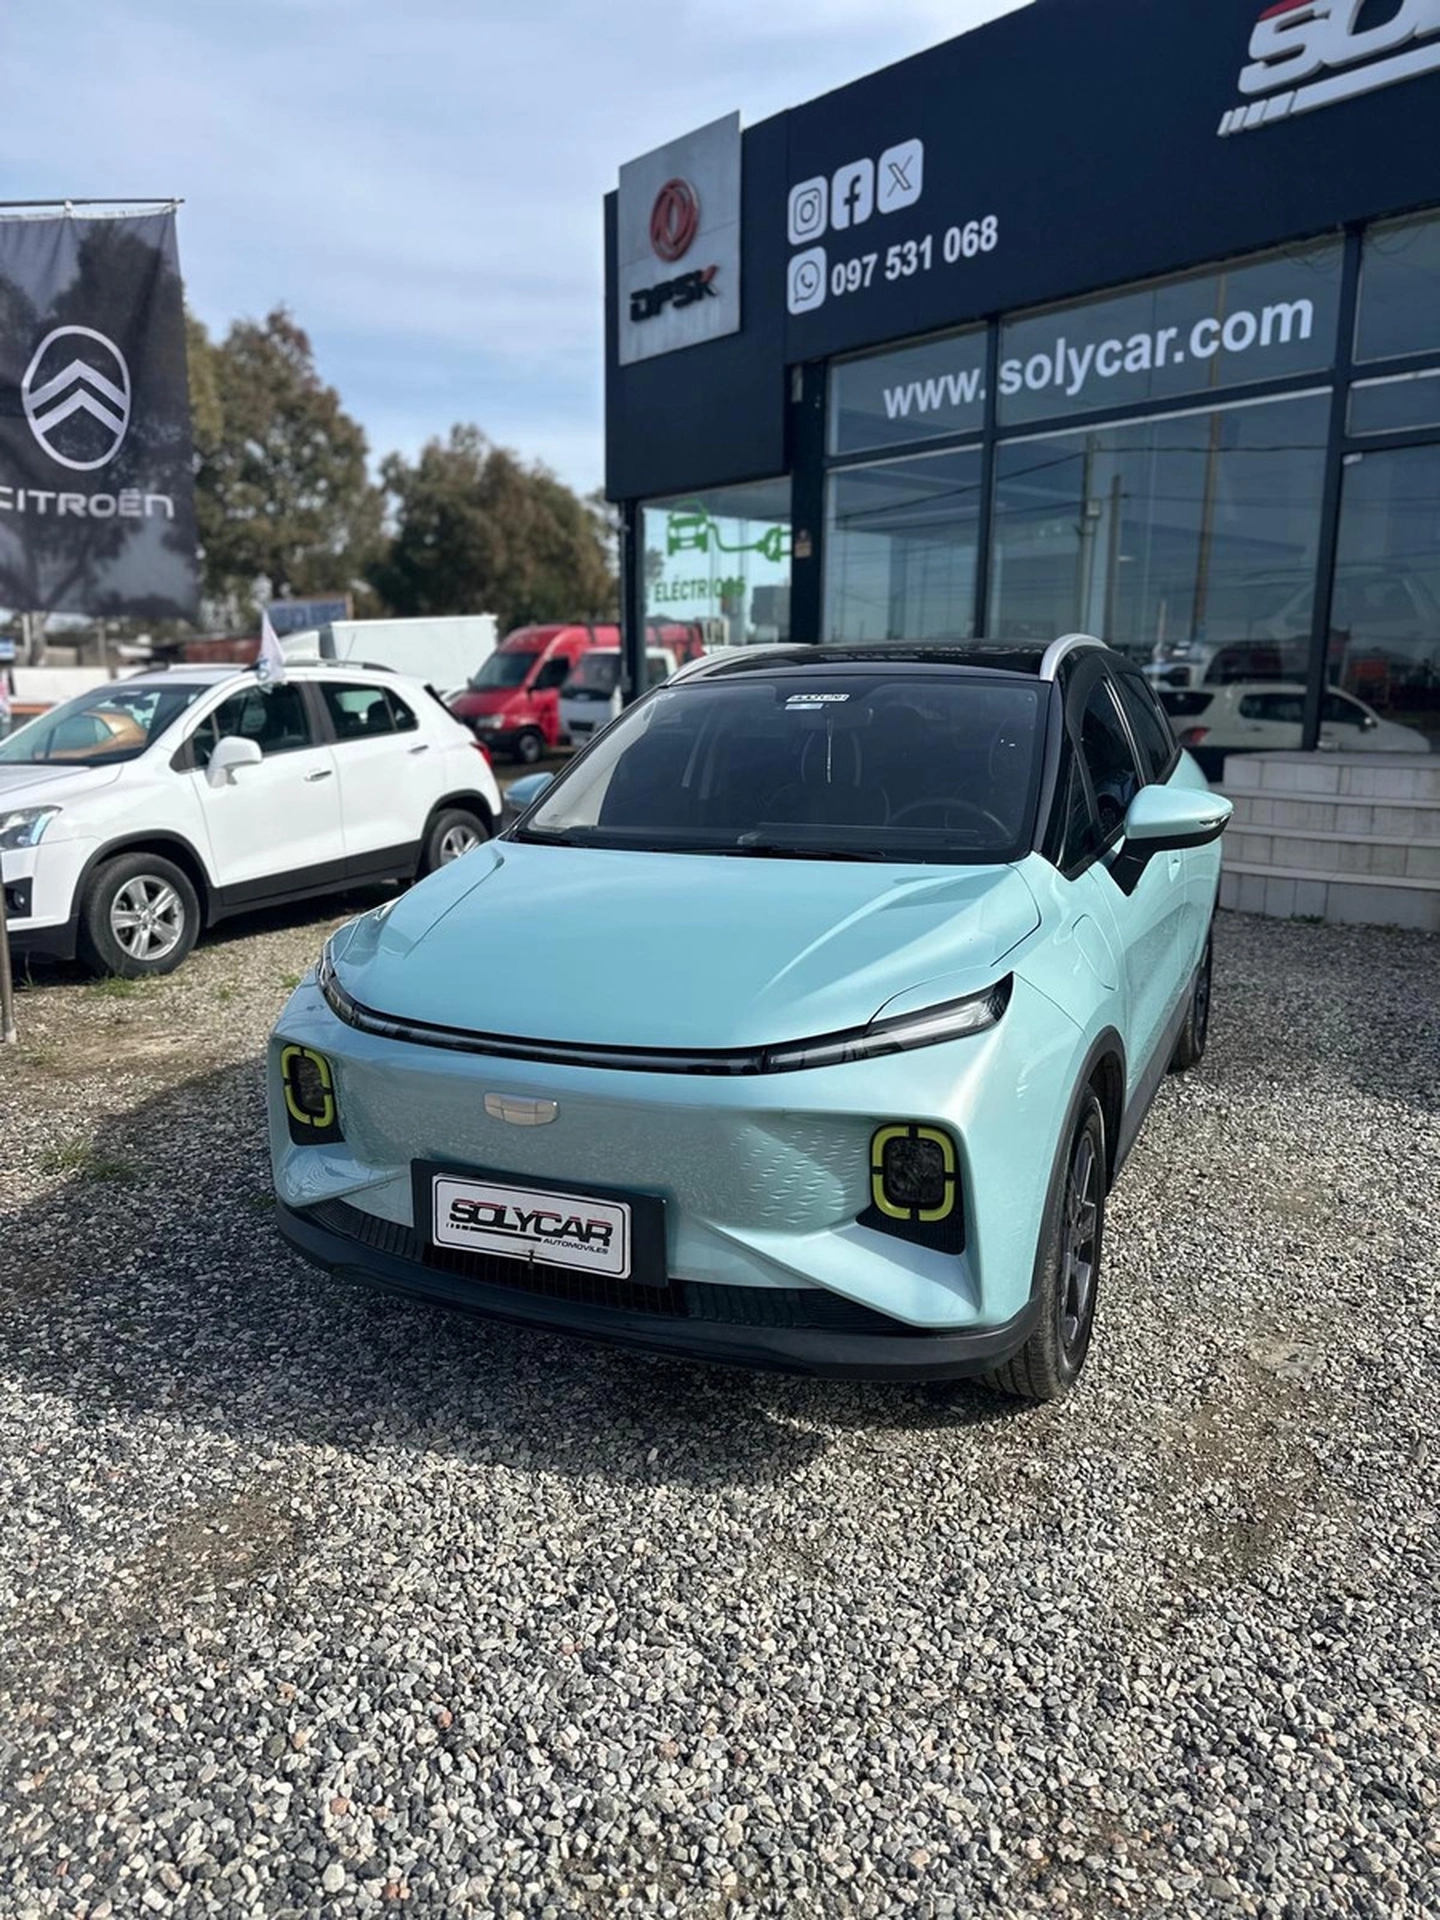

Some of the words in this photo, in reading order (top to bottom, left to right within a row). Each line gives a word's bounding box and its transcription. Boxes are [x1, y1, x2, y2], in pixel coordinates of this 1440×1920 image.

[831, 262, 878, 296] 097
[885, 234, 932, 280] 531
[943, 214, 999, 263] 068
[449, 1198, 613, 1247] SOLYCAR
[543, 1237, 609, 1255] AUTOMOVILES
